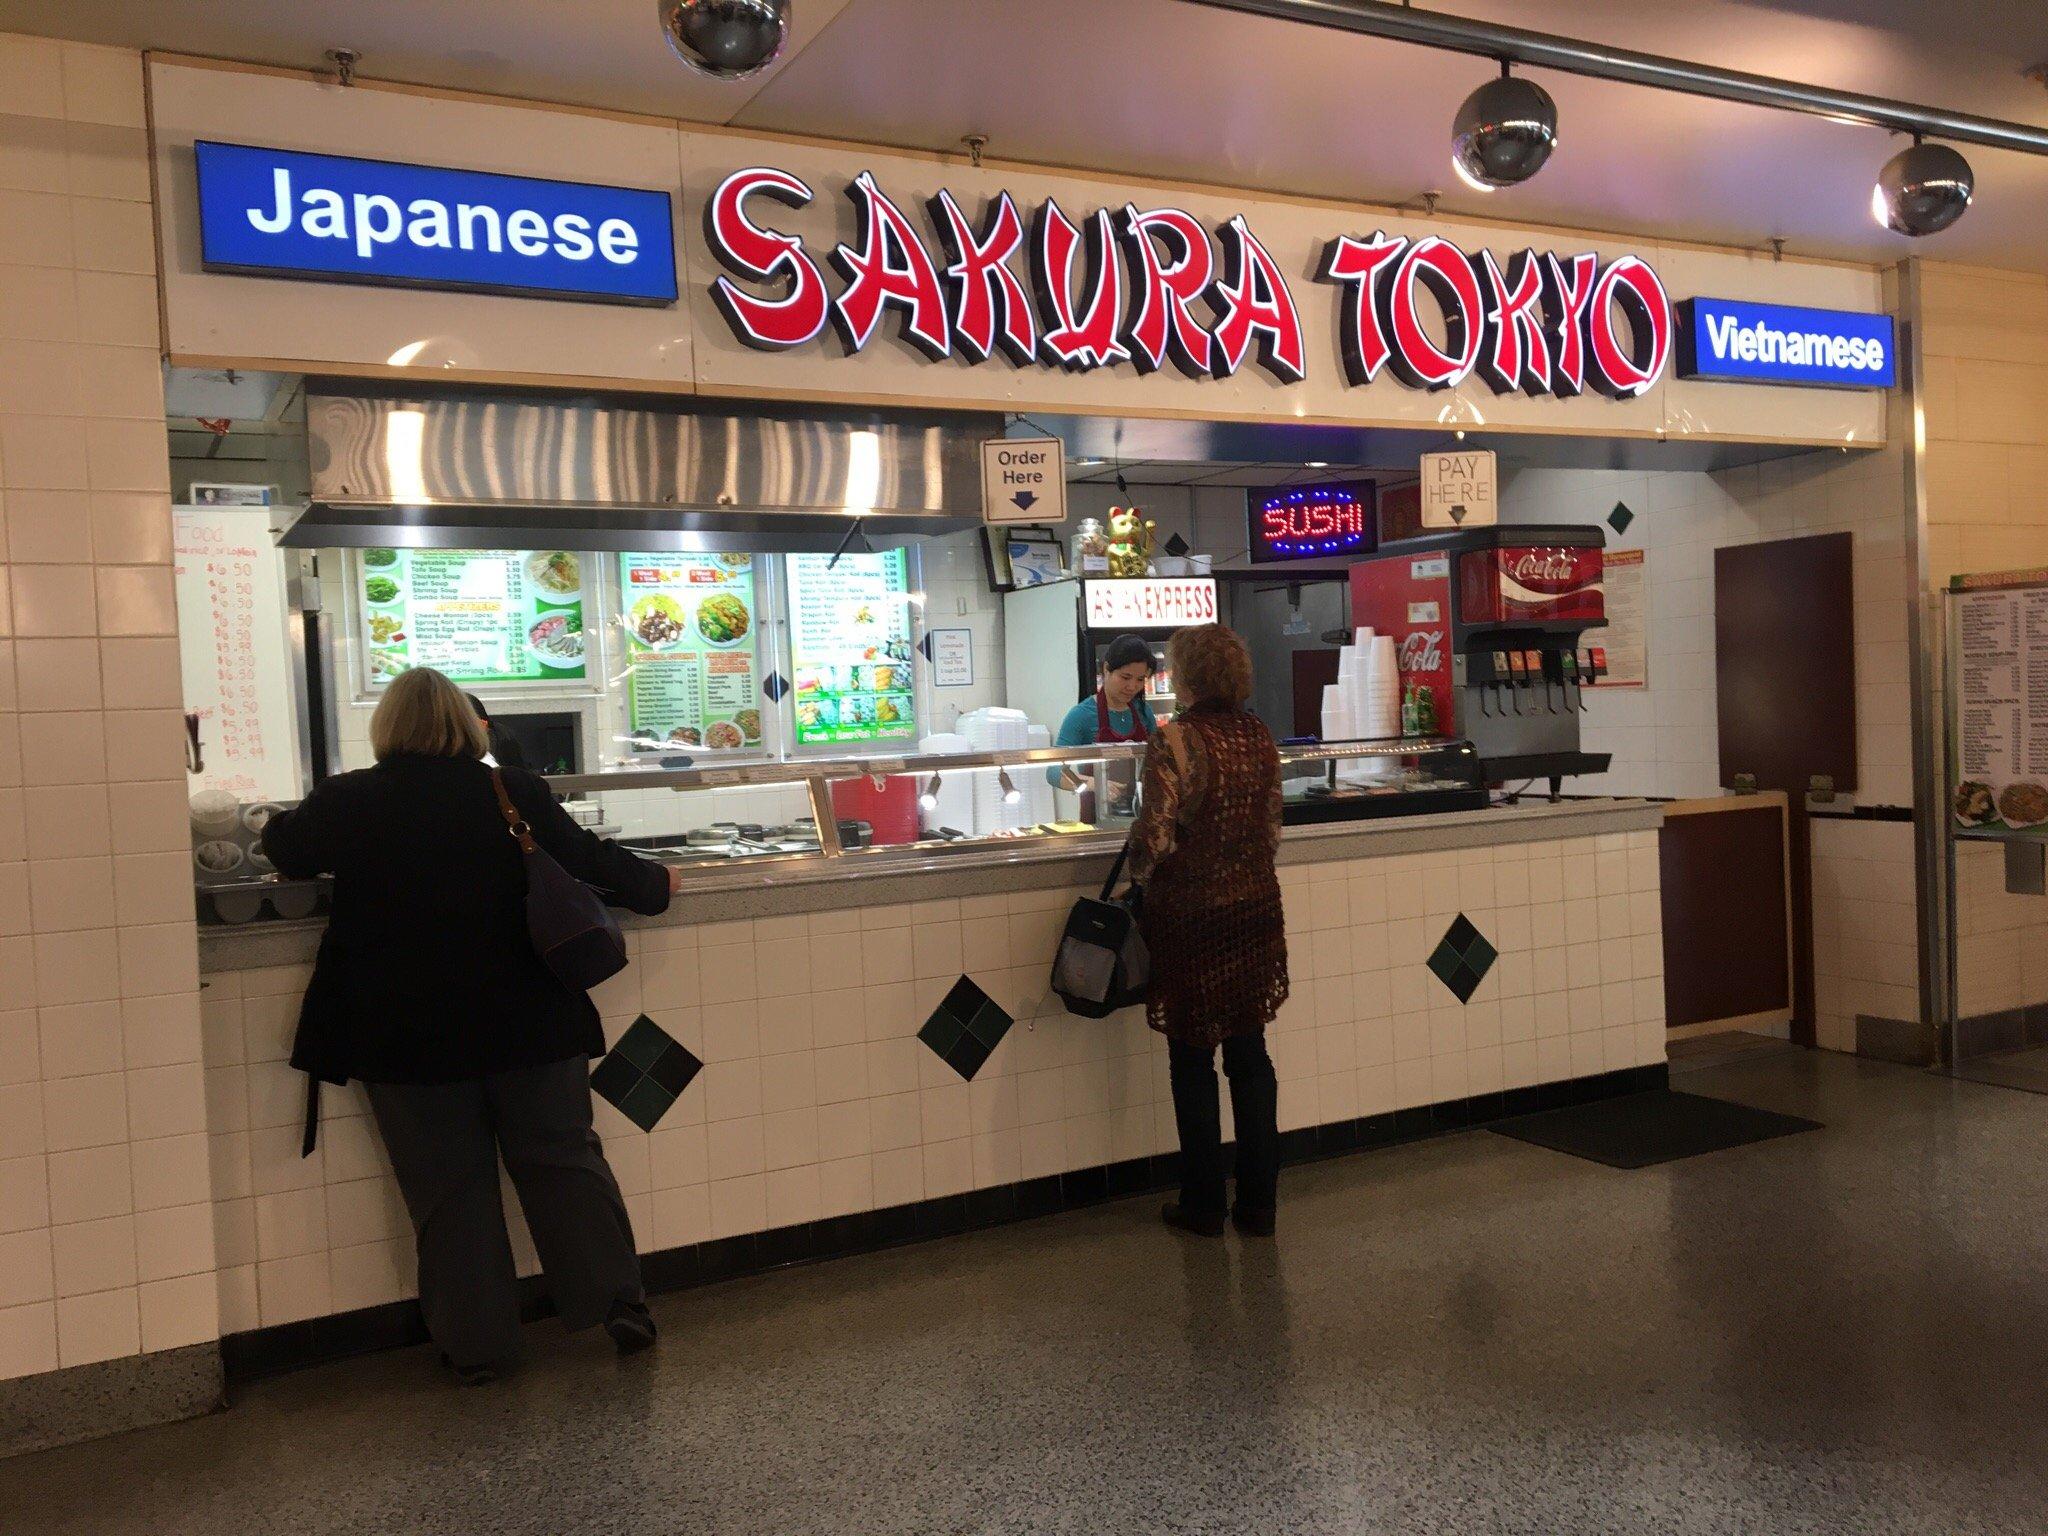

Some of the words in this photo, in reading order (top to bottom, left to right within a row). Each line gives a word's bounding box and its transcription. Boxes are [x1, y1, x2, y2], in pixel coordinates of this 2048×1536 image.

[247, 168, 638, 264] Japanese
[708, 167, 1306, 382] SAKURA
[1326, 231, 1672, 397] TOKYO
[1706, 314, 1885, 370] Vietnamese
[998, 451, 1046, 465] Order
[1439, 457, 1478, 481] PAY
[1003, 471, 1043, 484] Here
[1430, 482, 1488, 503] HERE
[1264, 503, 1362, 538] SUSHI
[1145, 585, 1213, 618] EXPRESS
